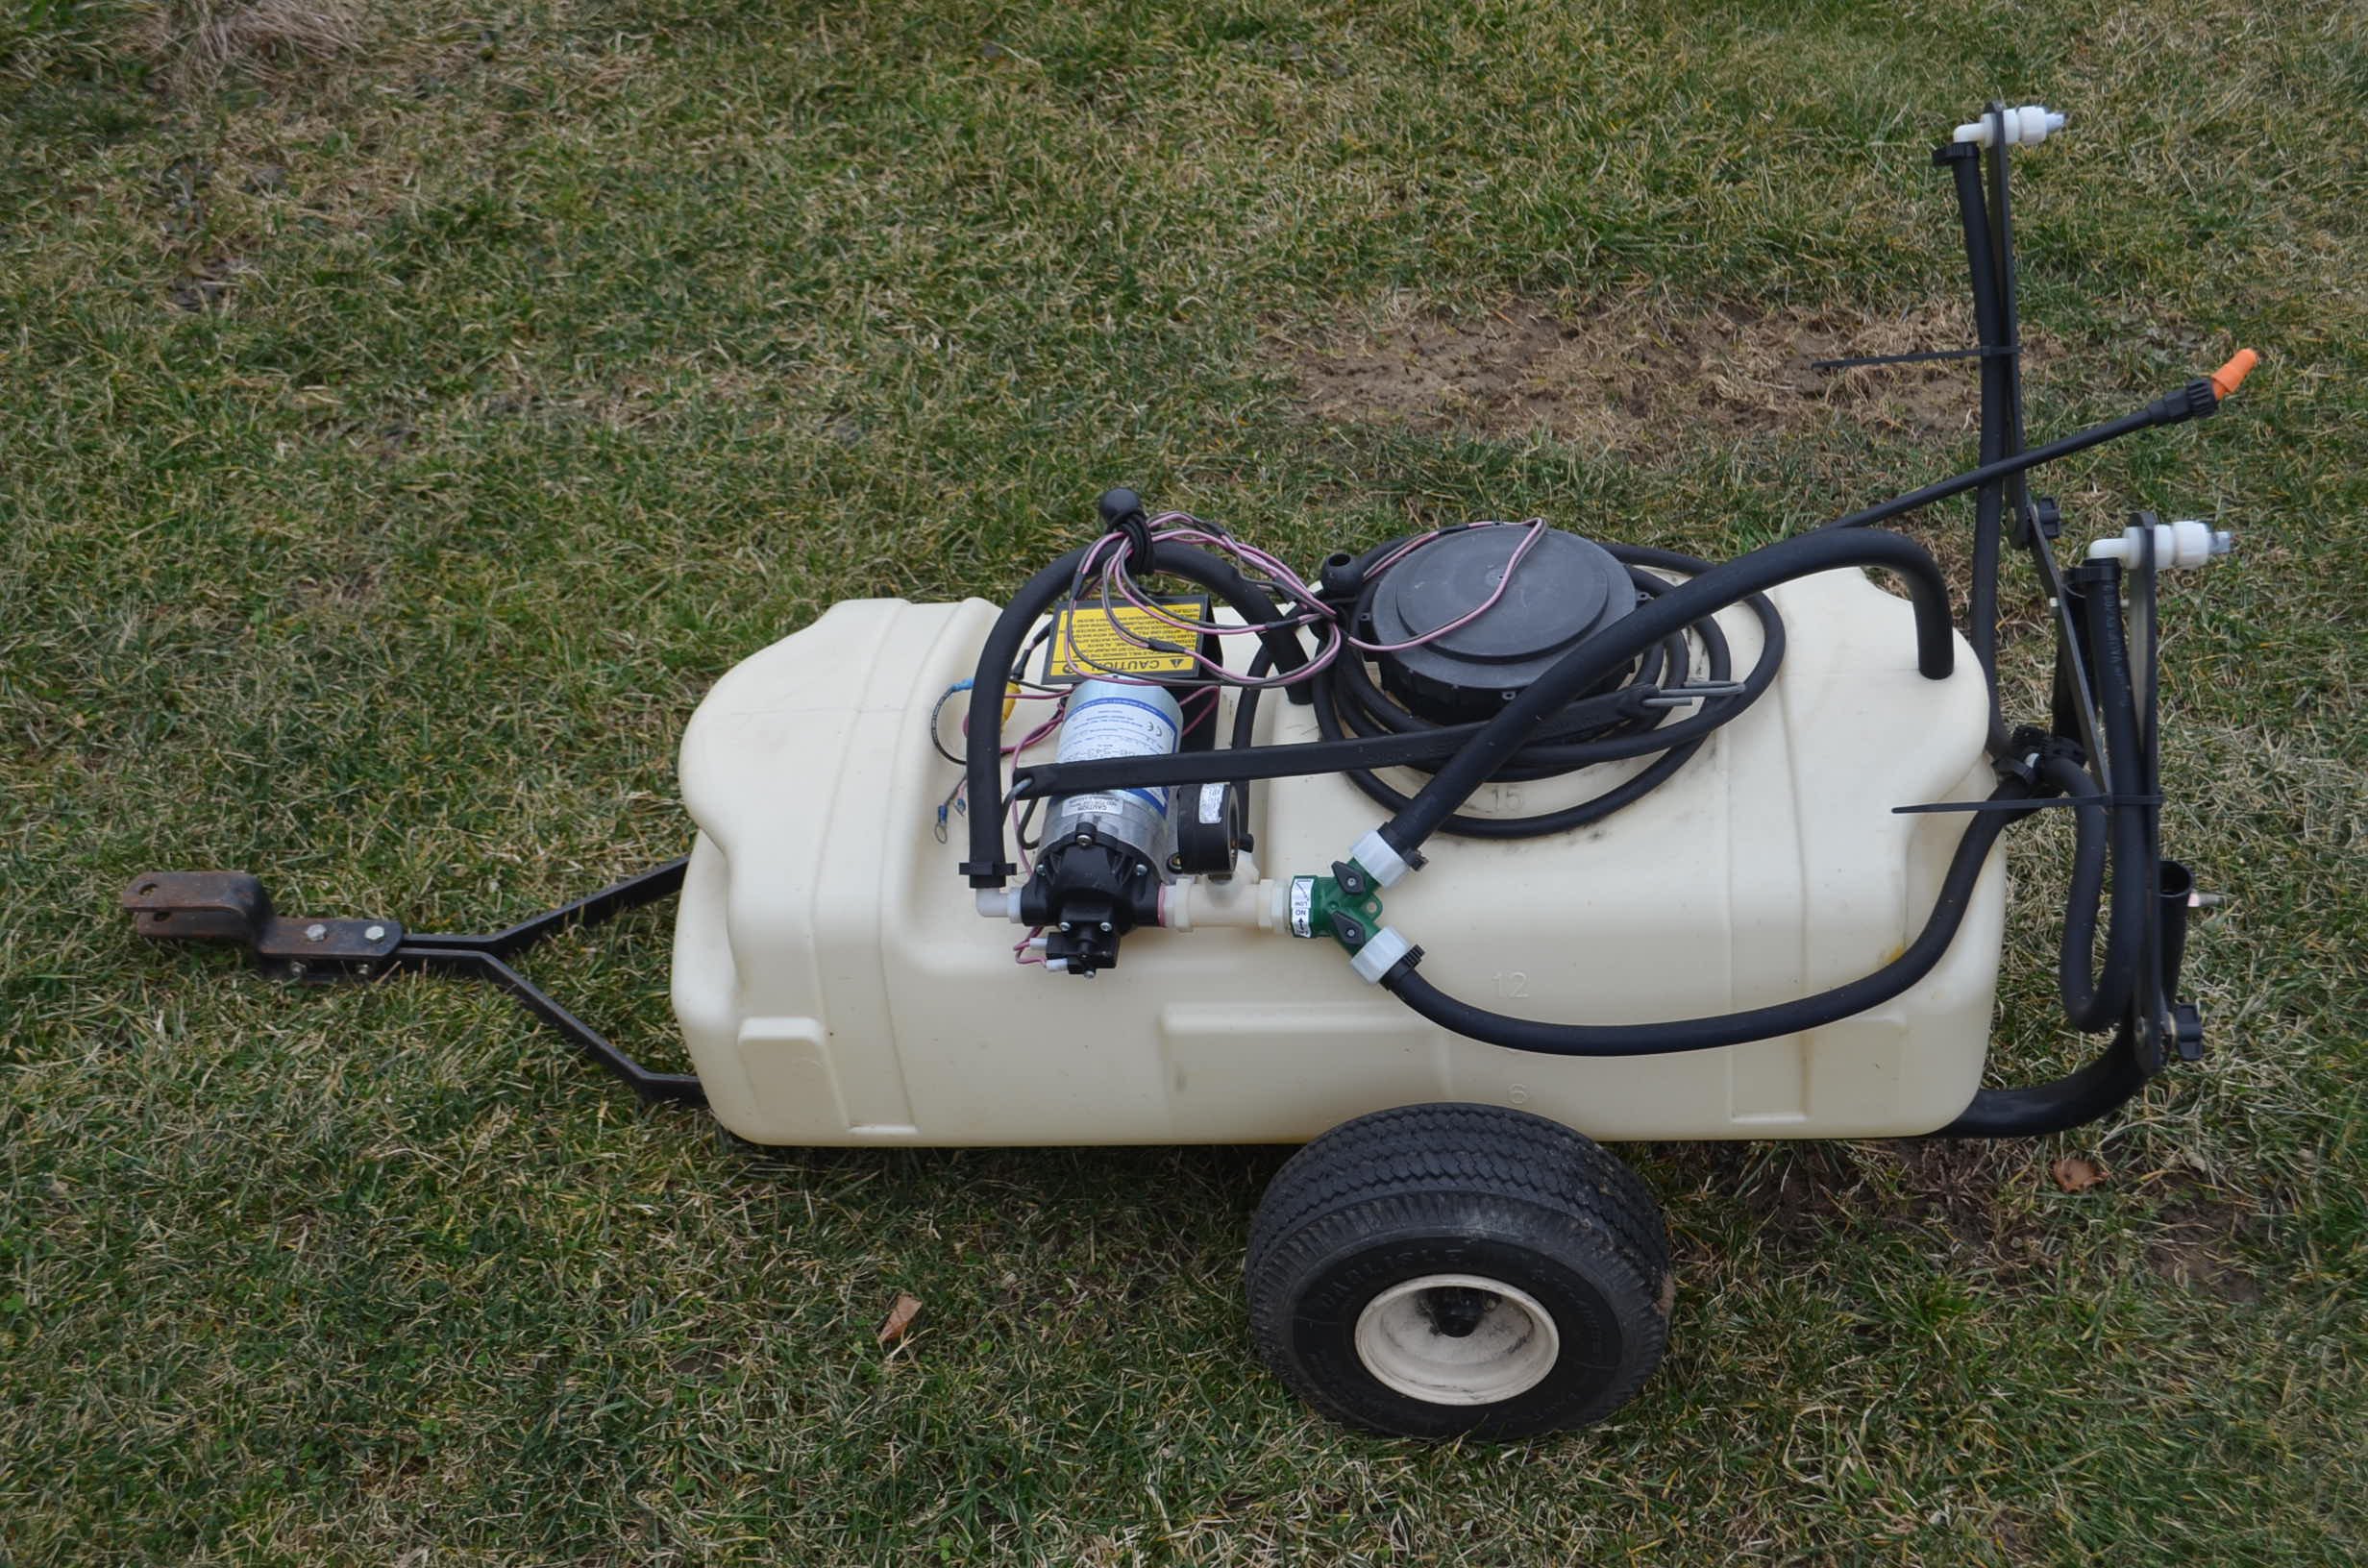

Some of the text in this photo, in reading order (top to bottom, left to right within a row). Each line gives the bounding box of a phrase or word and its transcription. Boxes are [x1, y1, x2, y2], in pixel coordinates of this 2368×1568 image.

[1091, 659, 1160, 672] CAUTIO
[1492, 970, 1531, 999] 12
[1507, 1083, 1530, 1104] 6
